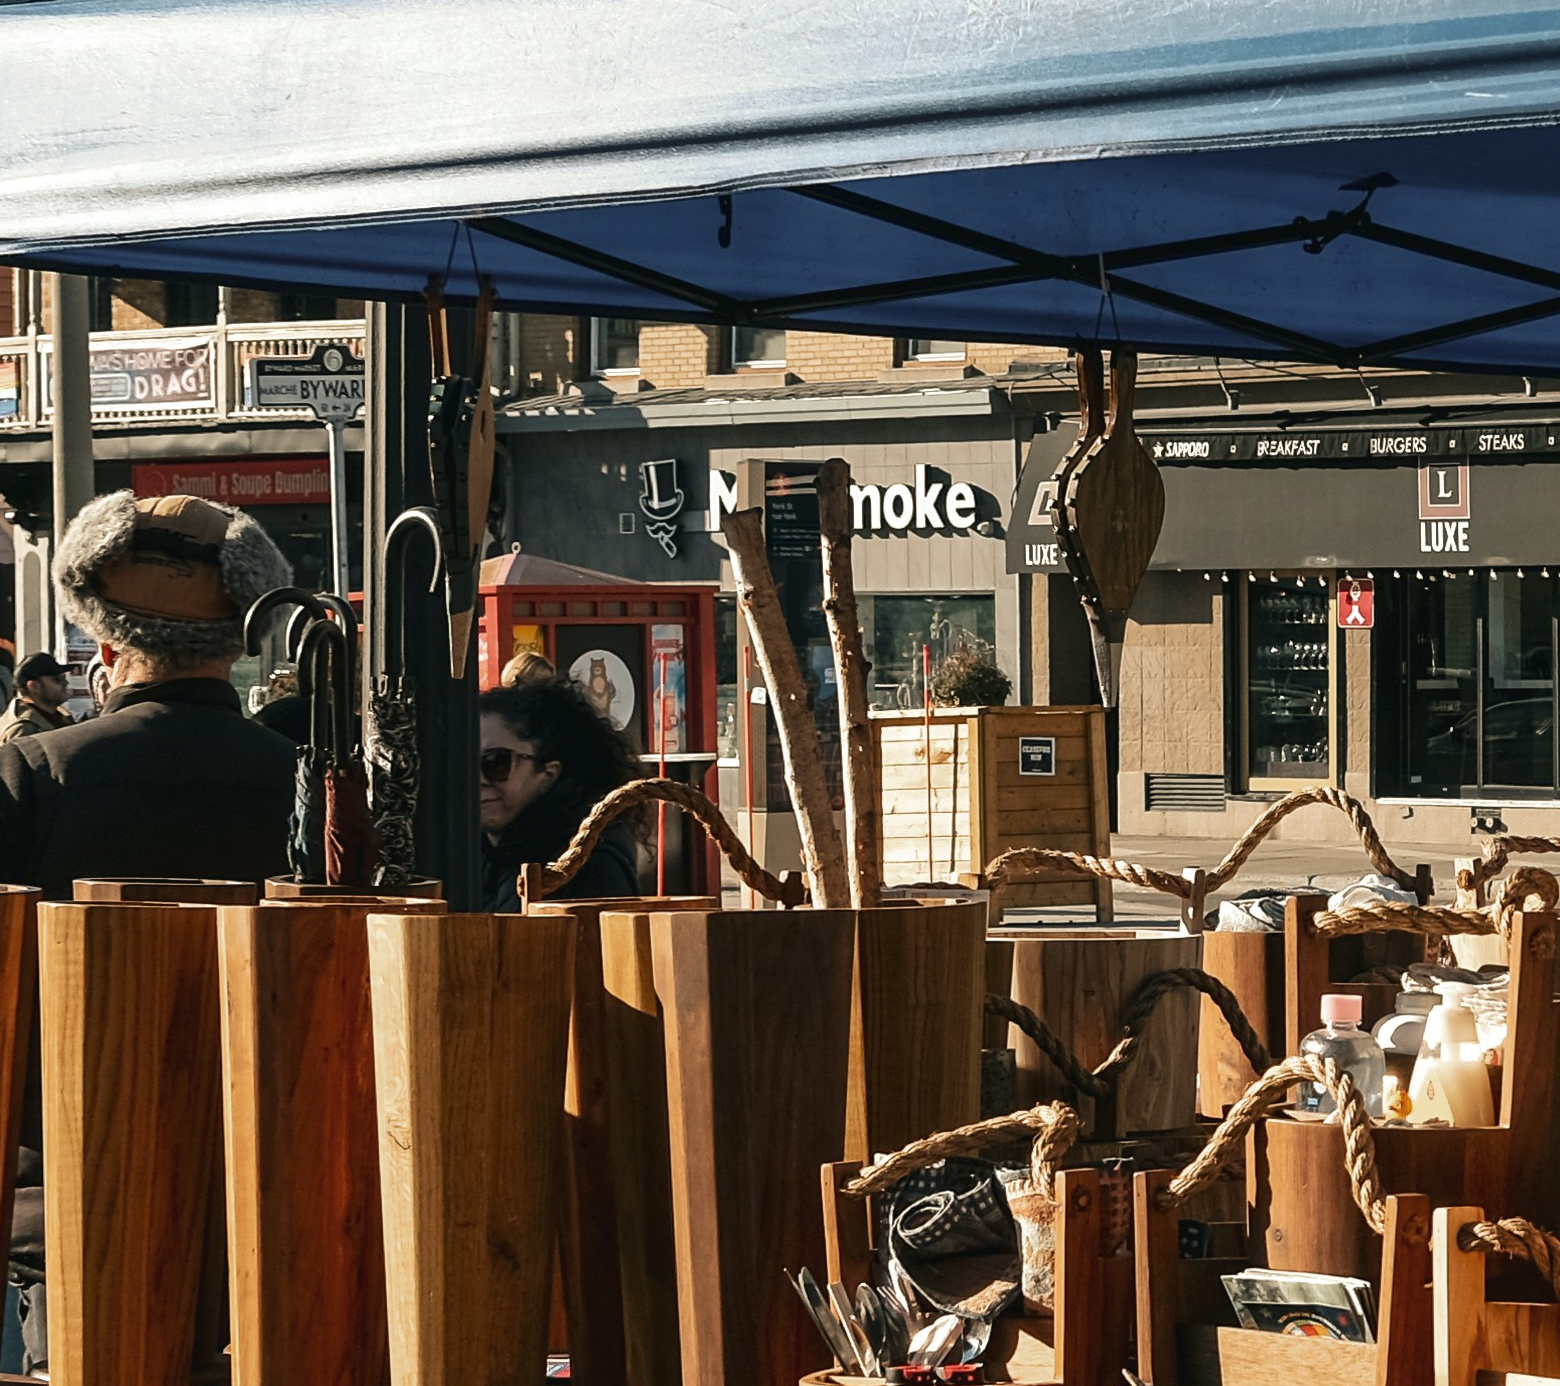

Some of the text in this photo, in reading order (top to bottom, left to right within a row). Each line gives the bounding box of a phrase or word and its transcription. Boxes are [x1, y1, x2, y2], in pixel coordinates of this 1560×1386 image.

[125, 351, 173, 370] HOME
[134, 367, 209, 400] DRAG!
[1164, 441, 1210, 458] SAPPORO
[1257, 439, 1321, 457] BREAKFAST
[1370, 437, 1427, 455] BURGERS
[1478, 433, 1525, 452] STEAKS
[171, 471, 217, 498] Sammi
[231, 469, 272, 498] Soupe
[274, 467, 329, 496] Dumplin
[849, 463, 977, 530] moke
[1437, 470, 1453, 499] L
[1420, 521, 1470, 553] LUXE
[1024, 543, 1058, 567] LUXE
